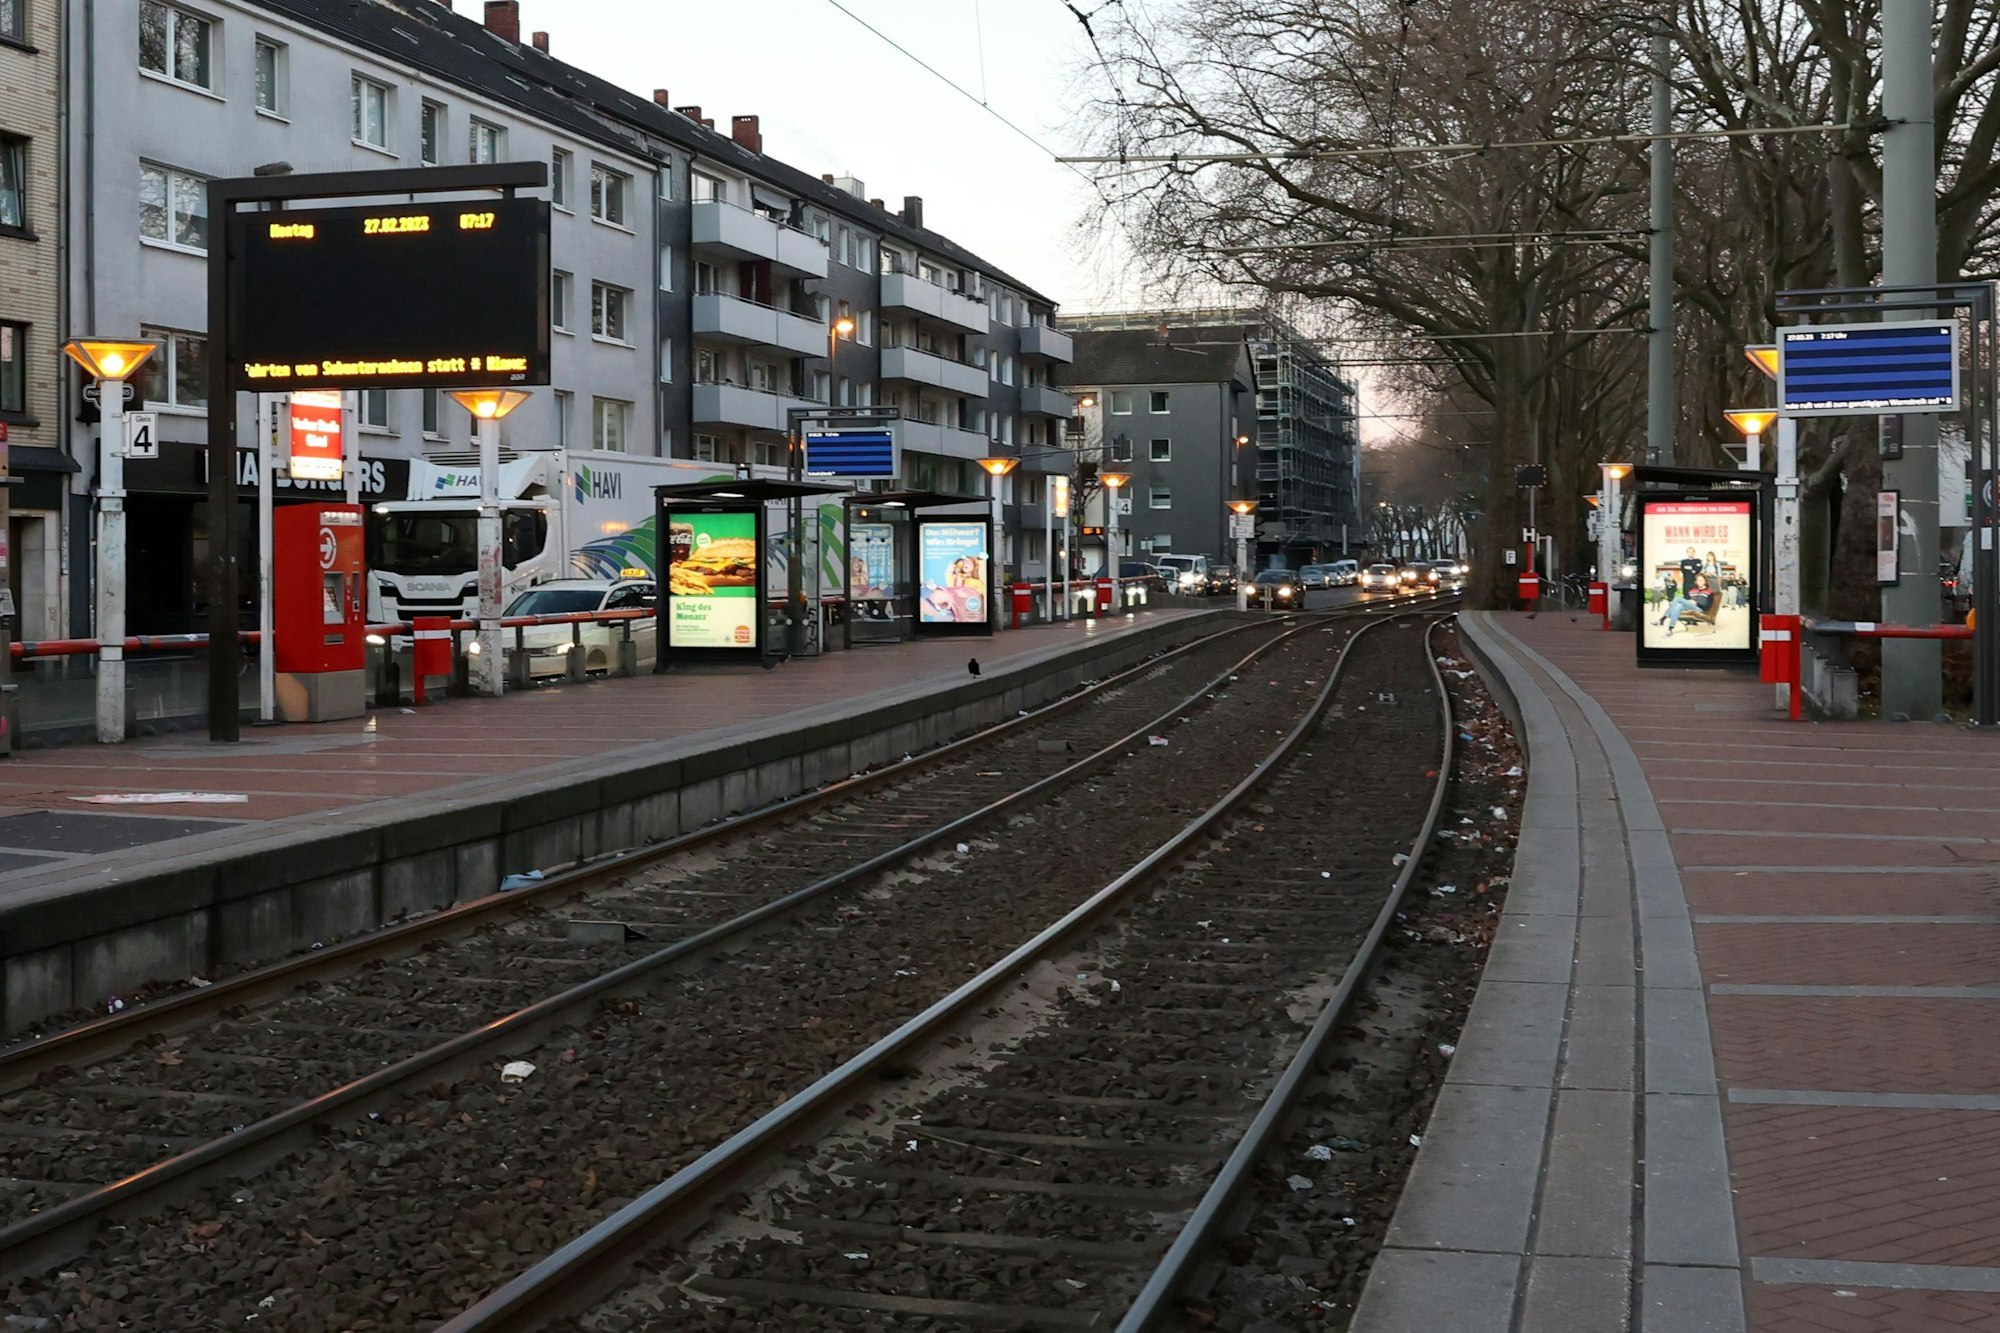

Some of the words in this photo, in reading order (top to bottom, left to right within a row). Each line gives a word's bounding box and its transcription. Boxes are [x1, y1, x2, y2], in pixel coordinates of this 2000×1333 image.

[363, 216, 430, 234] 27.02.2023
[459, 212, 496, 230] 07:17
[427, 357, 466, 373] statt
[133, 425, 153, 453] 4
[592, 470, 622, 500] HAVI
[1120, 502, 1130, 513] 4
[1522, 527, 1536, 543] H
[1664, 525, 1690, 538] WANN
[1692, 525, 1716, 538] WIRD
[1718, 525, 1729, 538] ES
[1507, 552, 1514, 562] F
[675, 602, 697, 612] King
[697, 601, 712, 611] des
[675, 612, 707, 621] Monats
